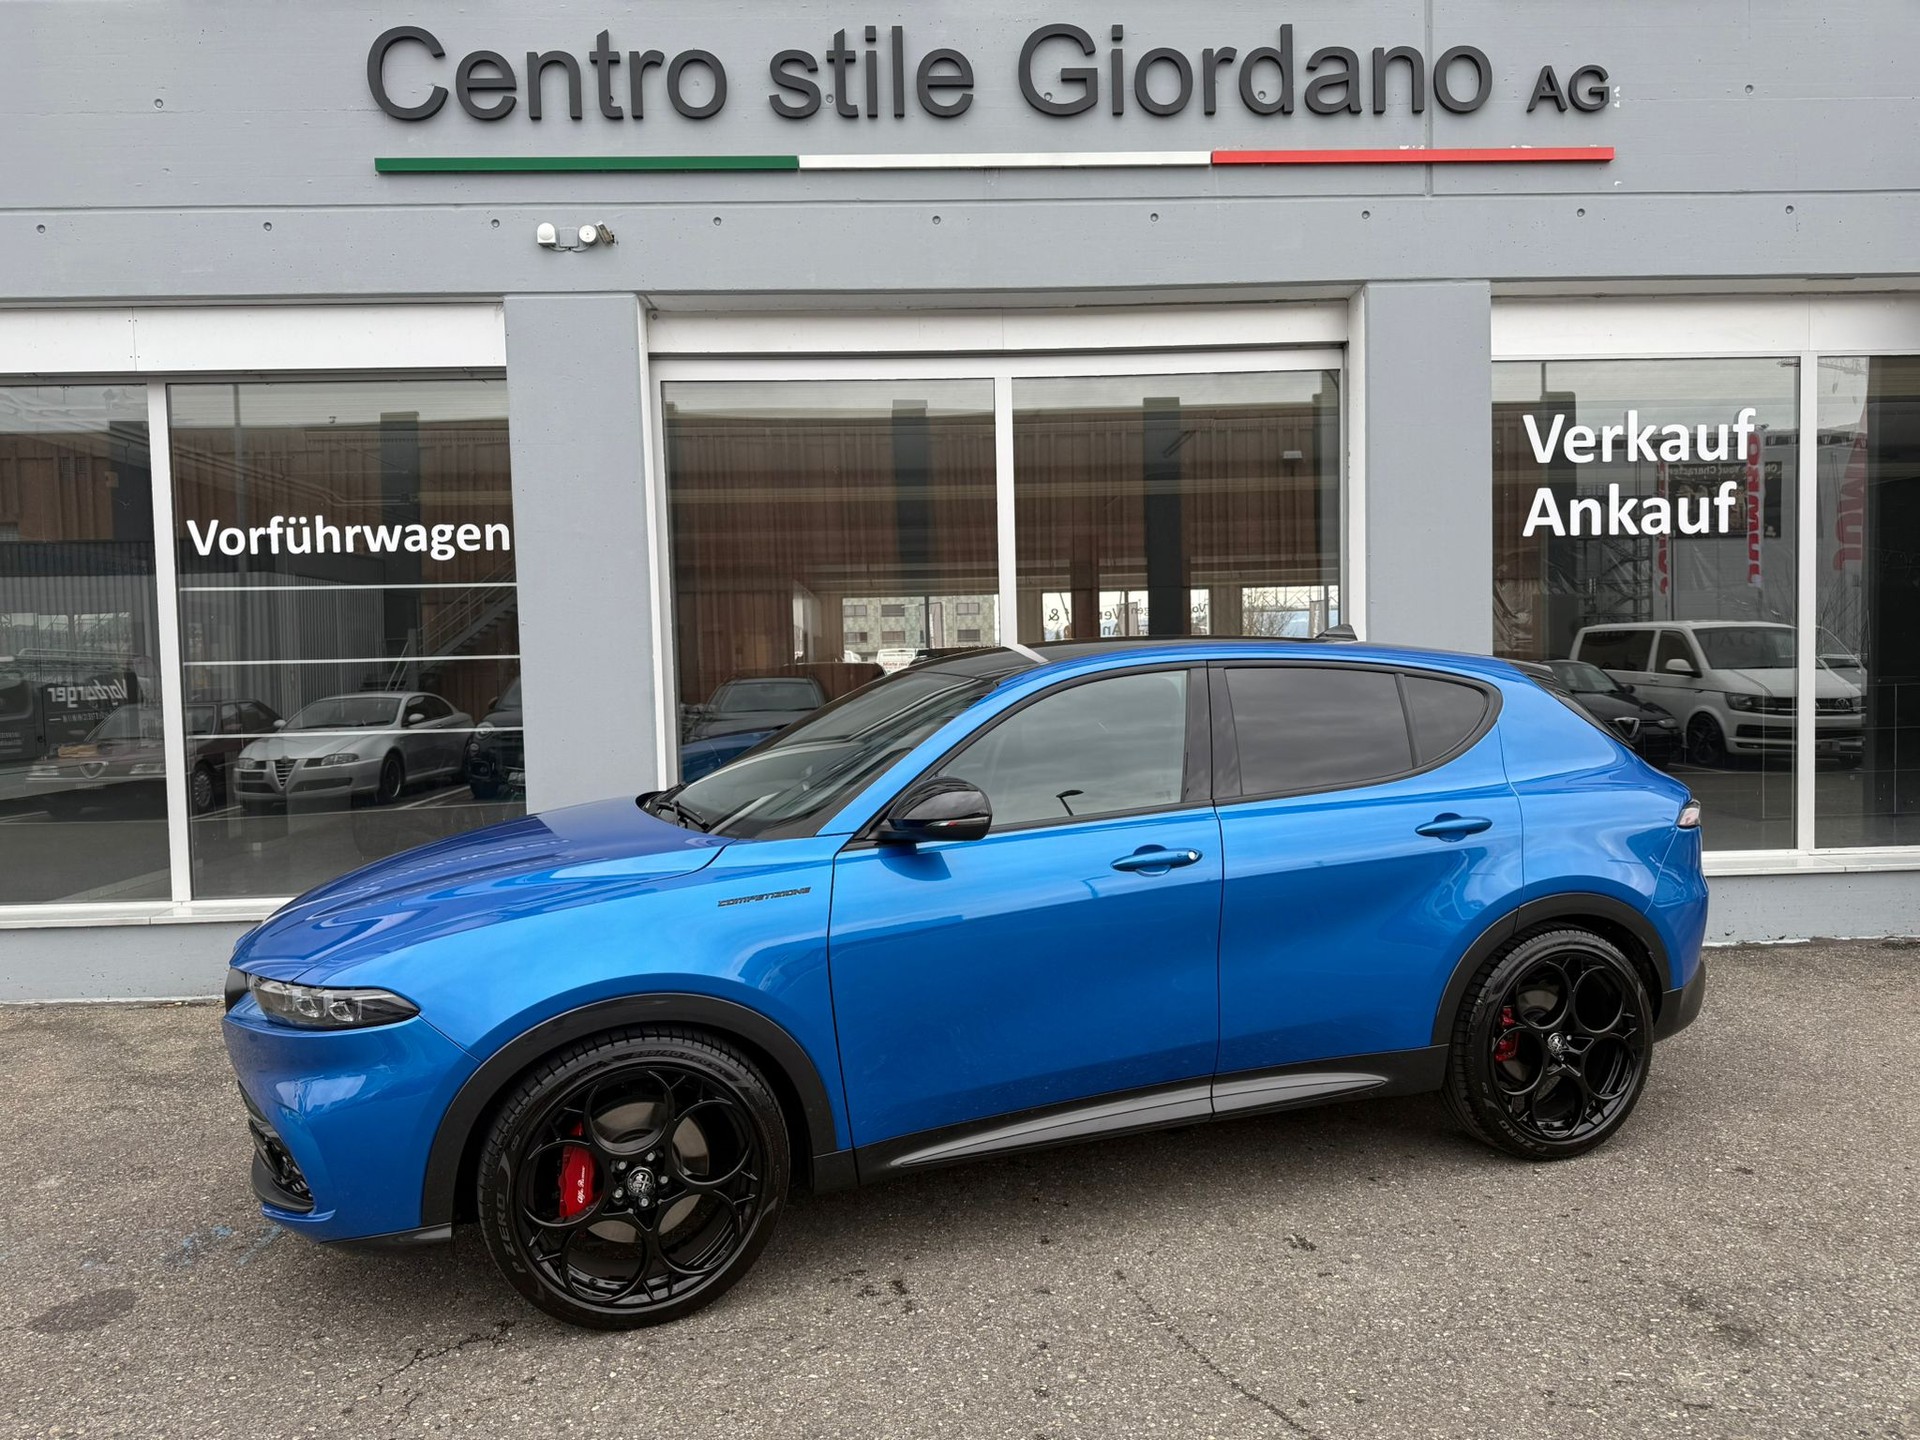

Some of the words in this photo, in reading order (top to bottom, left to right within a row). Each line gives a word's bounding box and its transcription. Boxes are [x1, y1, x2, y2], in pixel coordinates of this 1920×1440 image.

[366, 25, 728, 122] Centro
[768, 24, 975, 120] stile
[1018, 22, 1494, 117] Giordano
[1526, 63, 1612, 113] AG
[1522, 407, 1757, 465] Verkauf
[185, 515, 511, 560] Vorführwagen
[1522, 481, 1738, 538] Ankauf
[1498, 1119, 1536, 1148] ZERO
[495, 1191, 517, 1257] ZERO
